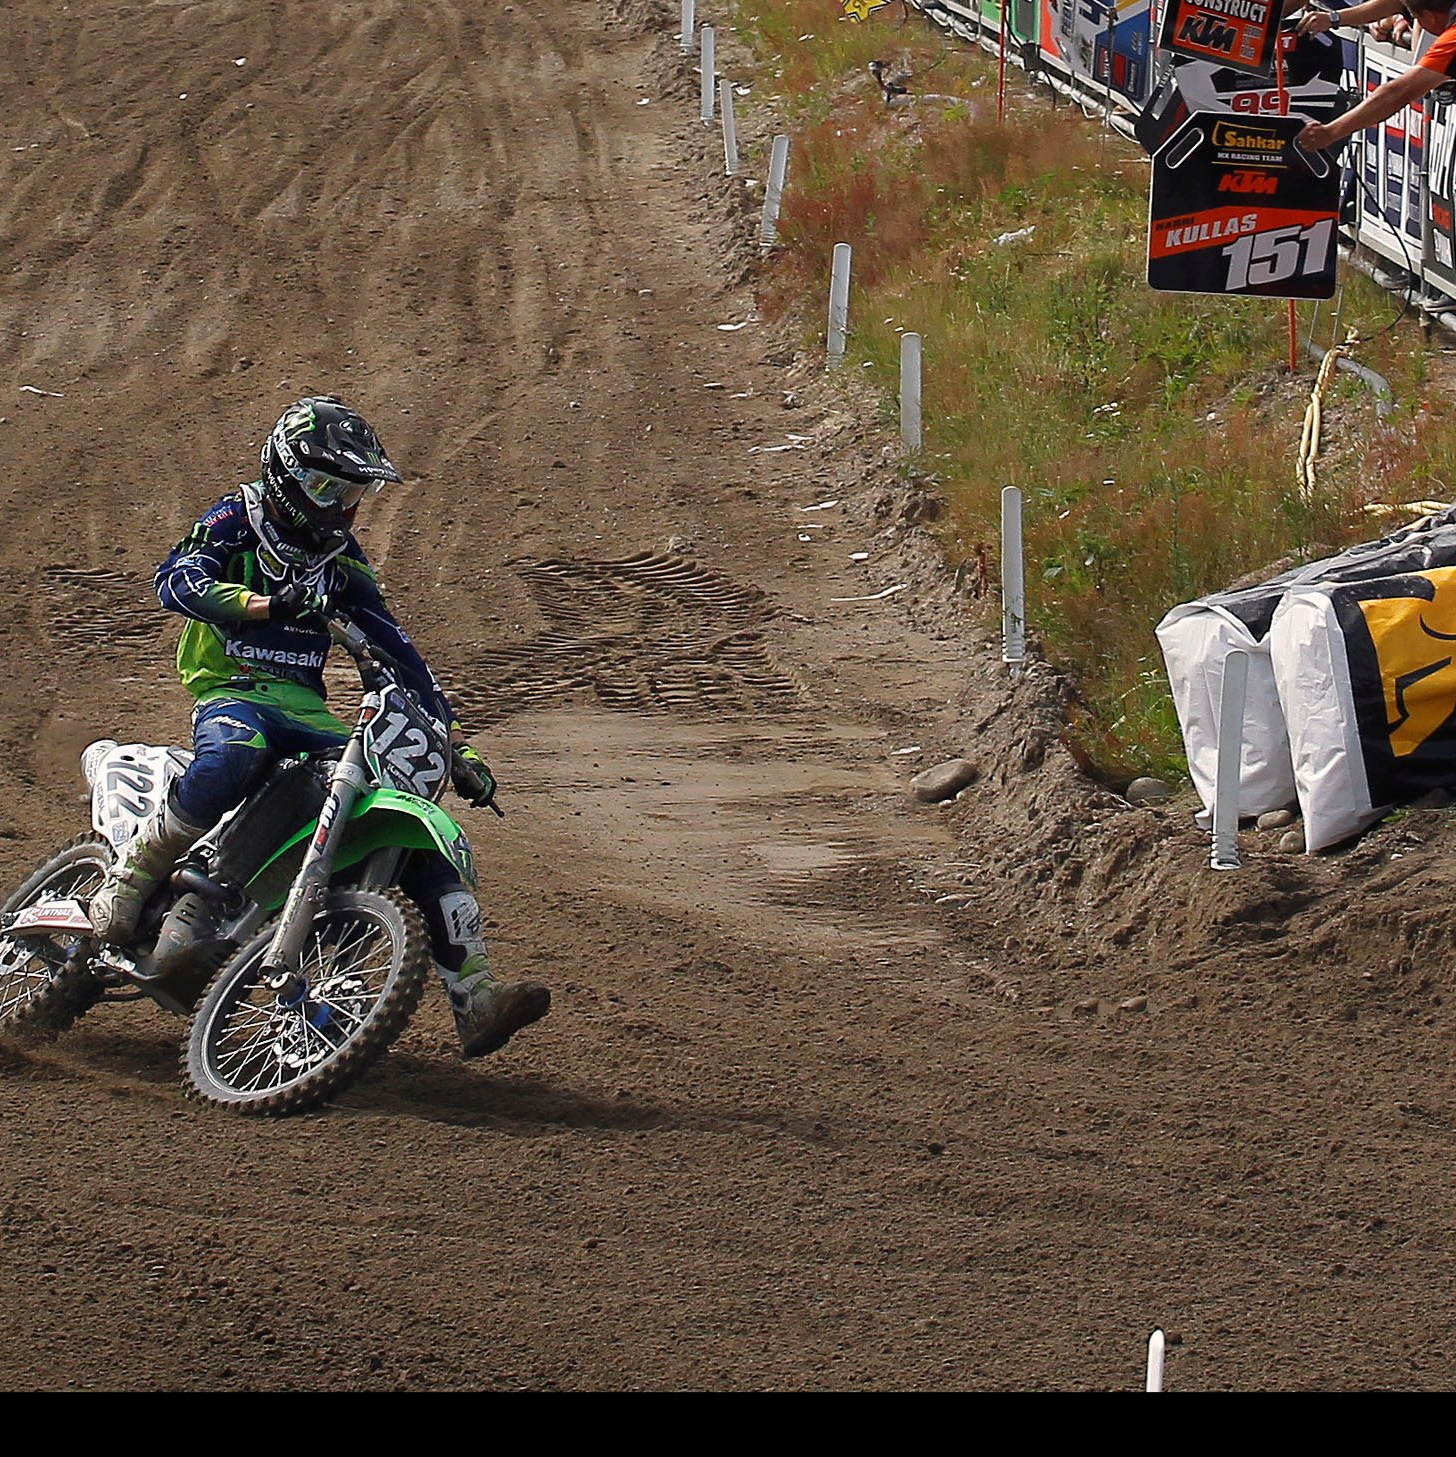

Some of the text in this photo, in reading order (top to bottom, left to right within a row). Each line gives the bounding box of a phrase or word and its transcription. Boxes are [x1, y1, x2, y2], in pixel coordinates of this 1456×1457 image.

[1177, 10, 1239, 55] KTM
[1231, 153, 1261, 162] RACING
[1262, 154, 1284, 163] TEAM
[1217, 169, 1280, 195] KTM
[1165, 213, 1258, 249] KULLAS
[1221, 218, 1334, 292] 151
[225, 639, 324, 669] Kawasaki
[369, 711, 446, 799] 122
[106, 760, 155, 819] 122
